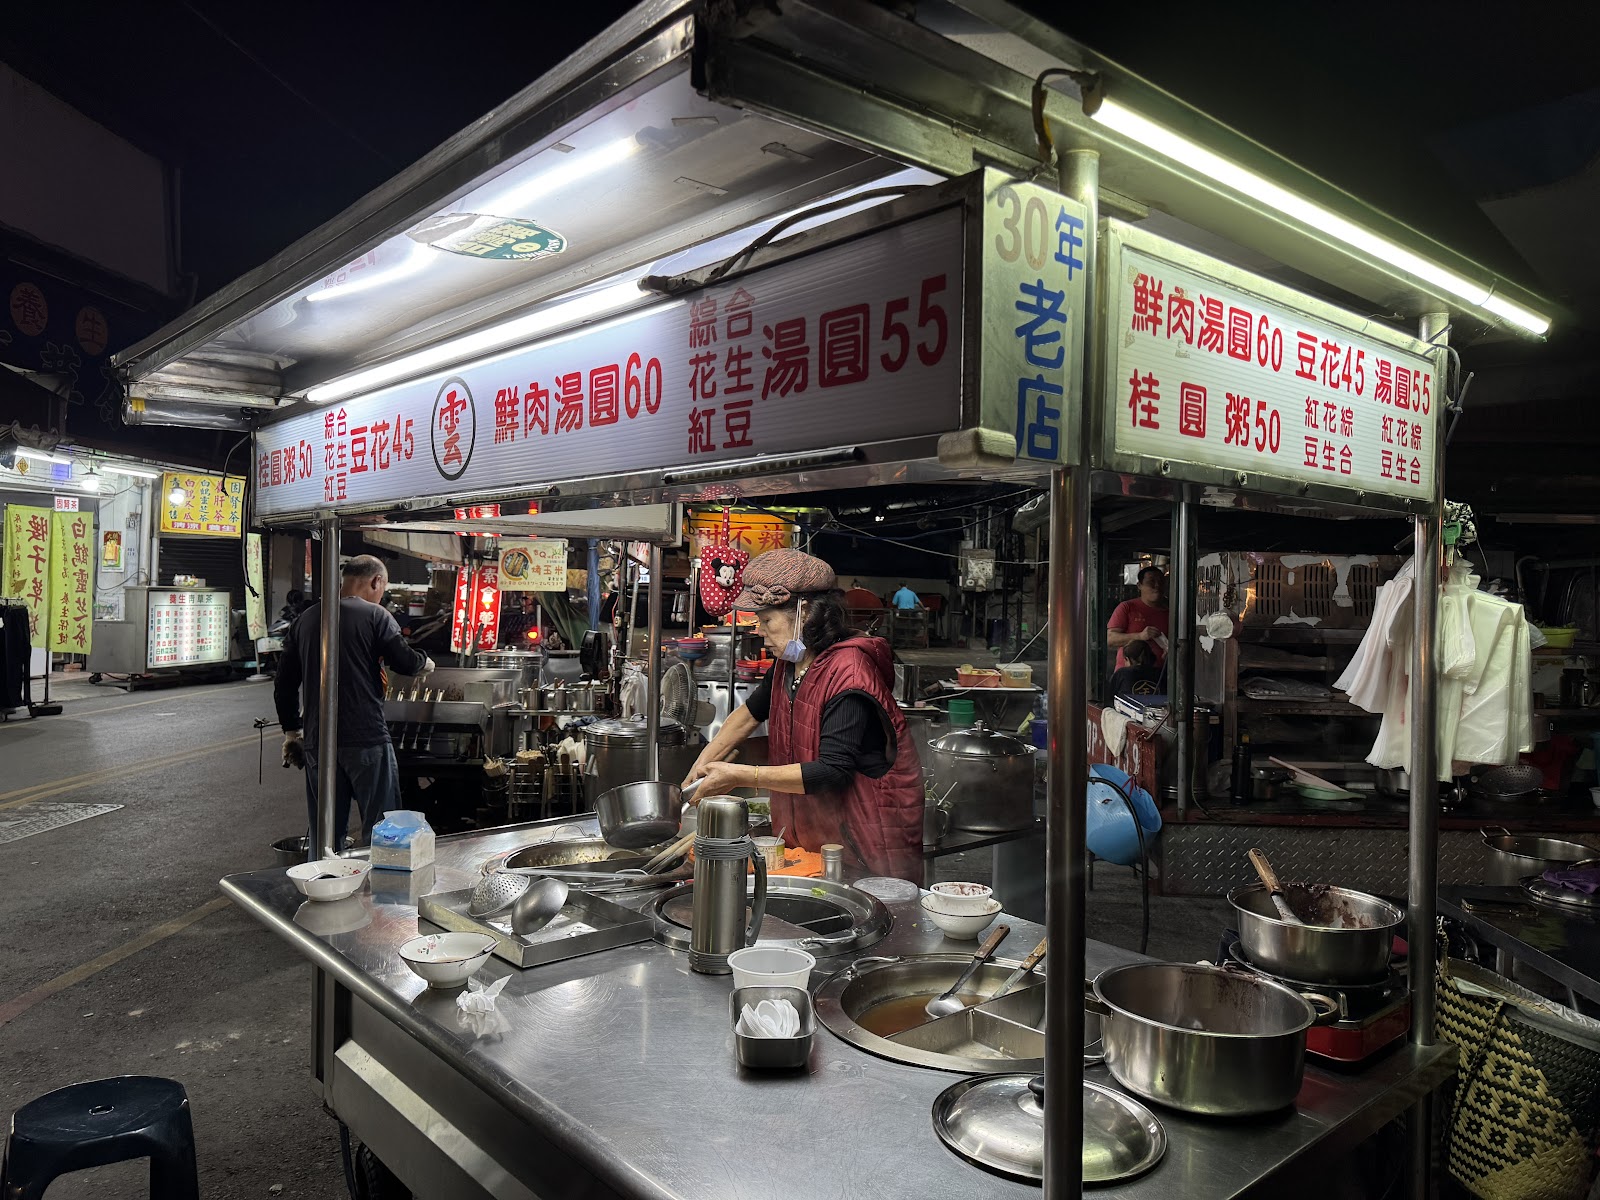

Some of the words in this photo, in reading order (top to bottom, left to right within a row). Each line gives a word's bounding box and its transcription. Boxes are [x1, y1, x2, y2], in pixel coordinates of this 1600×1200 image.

[689, 286, 756, 349] 綜合
[762, 273, 948, 401] 湯圓55
[1132, 272, 1283, 372] 鮮肉湯圓60
[688, 345, 754, 401] 花生
[1015, 279, 1068, 461] 老店
[1295, 331, 1365, 397] 豆花45
[1374, 357, 1431, 416] 湯圓55
[324, 407, 348, 440] 綜合
[438, 390, 467, 467] 雲
[494, 352, 662, 445] 鮮肉湯圓60
[688, 400, 754, 454] 紅豆
[324, 440, 348, 472] 花生
[349, 413, 414, 474] 豆花45
[324, 474, 348, 502] 紅豆
